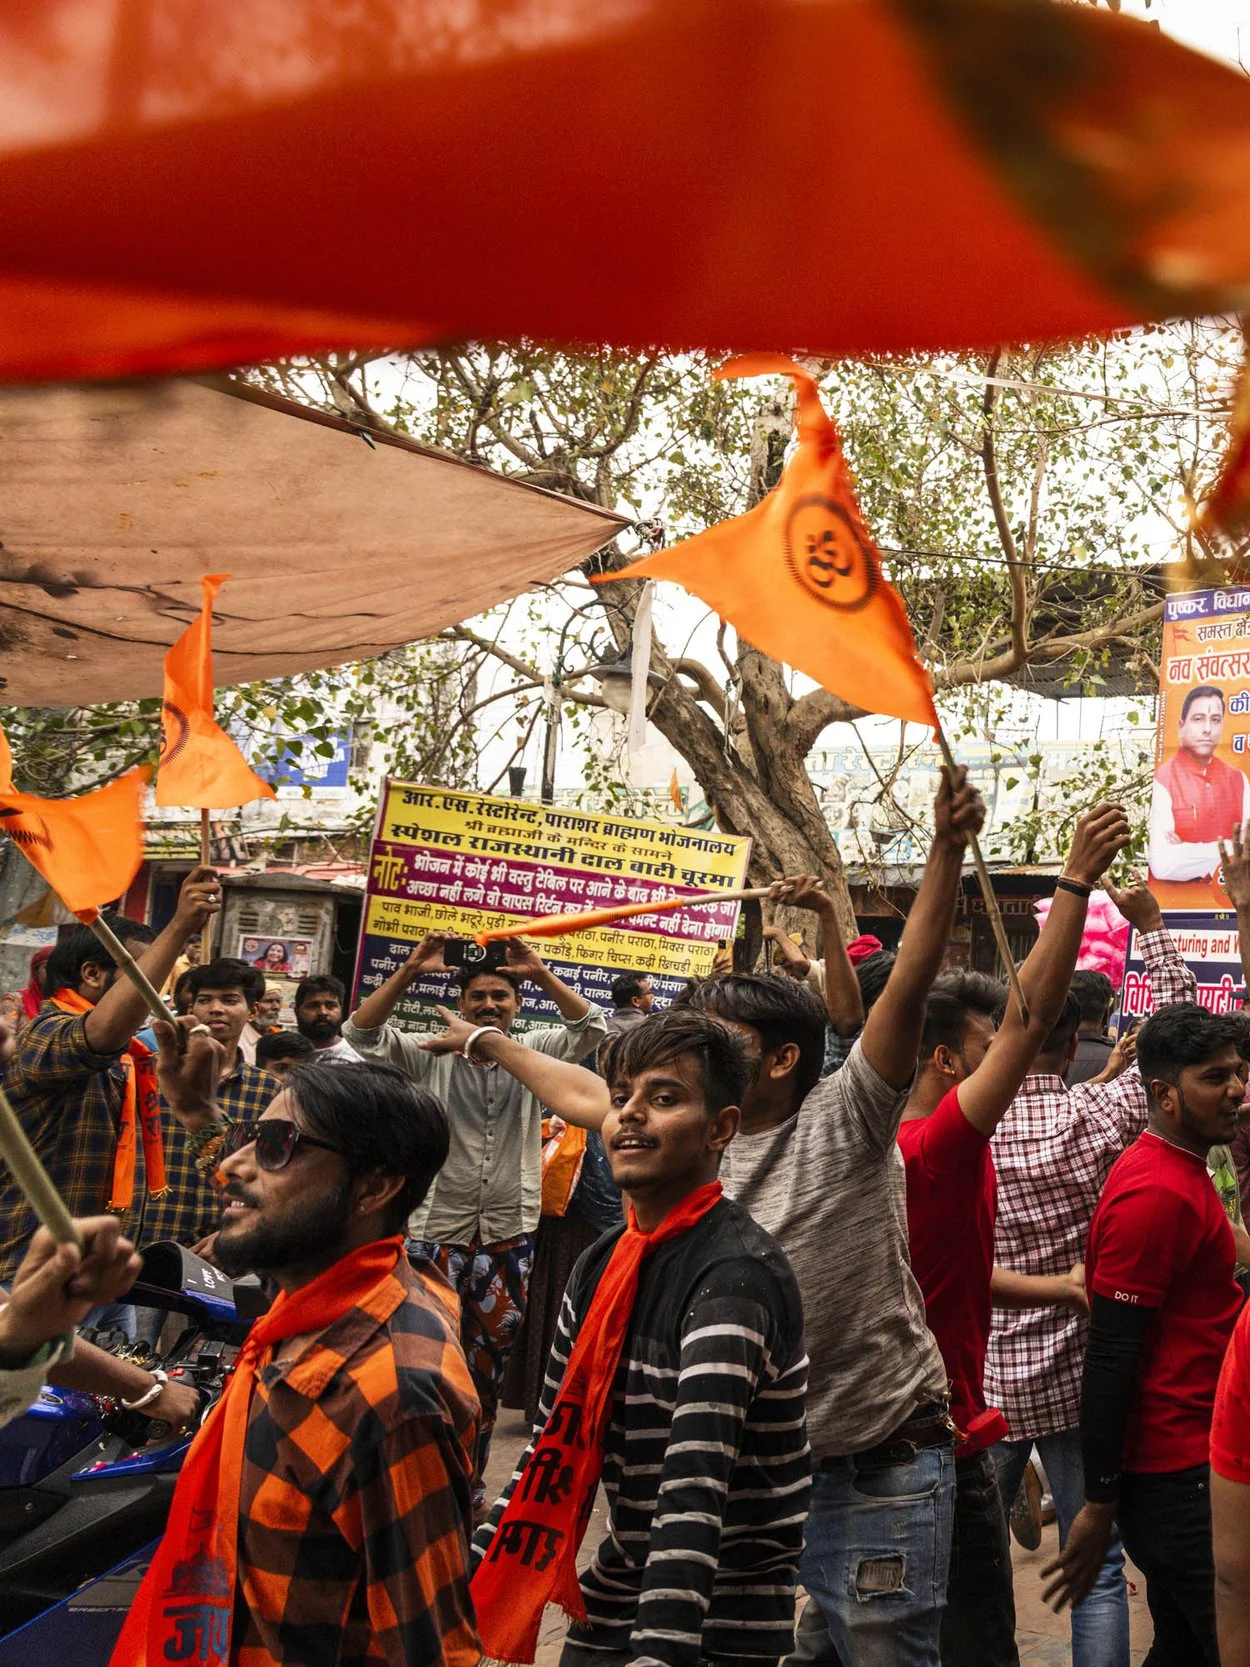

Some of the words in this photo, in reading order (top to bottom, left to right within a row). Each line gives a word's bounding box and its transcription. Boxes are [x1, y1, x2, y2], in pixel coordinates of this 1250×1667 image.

[1197, 624, 1231, 642] समस्त
[1169, 658, 1192, 682] नव
[1231, 692, 1250, 712] की
[1234, 736, 1244, 752] व
[465, 820, 483, 832] श्री
[546, 832, 561, 844] के
[612, 843, 626, 854] के
[632, 847, 673, 861] सामने
[659, 829, 737, 857] भोजनालय
[391, 822, 464, 847] स्पेशल
[468, 835, 578, 865] राजस्थानी
[581, 853, 626, 872] दाल
[630, 859, 678, 880] बाटी
[681, 868, 736, 889] चूरमा
[414, 850, 451, 876] भोजन
[454, 854, 466, 877] में
[465, 855, 490, 883] कोई
[491, 859, 507, 883] भी
[508, 869, 534, 892] वस्तु
[535, 867, 568, 892] टेबिल
[569, 878, 585, 894] पर
[586, 876, 613, 898] आने
[614, 878, 627, 900] के
[627, 886, 650, 904] बाद
[406, 880, 437, 898] अच्छा
[439, 881, 462, 903] नहीं
[463, 884, 485, 904] लगे
[487, 885, 500, 906] वो
[502, 893, 533, 911] वापस
[659, 911, 681, 934] नहीं
[682, 915, 704, 936] देना
[373, 916, 399, 933] गोभी
[402, 923, 430, 938] पराठा
[382, 901, 401, 914] पाव
[688, 944, 715, 957] पराठा
[389, 943, 410, 956] दाल
[1211, 935, 1232, 954] and
[371, 957, 396, 972] पनीर
[1114, 1291, 1129, 1302] DO
[1131, 1294, 1139, 1303] IT
